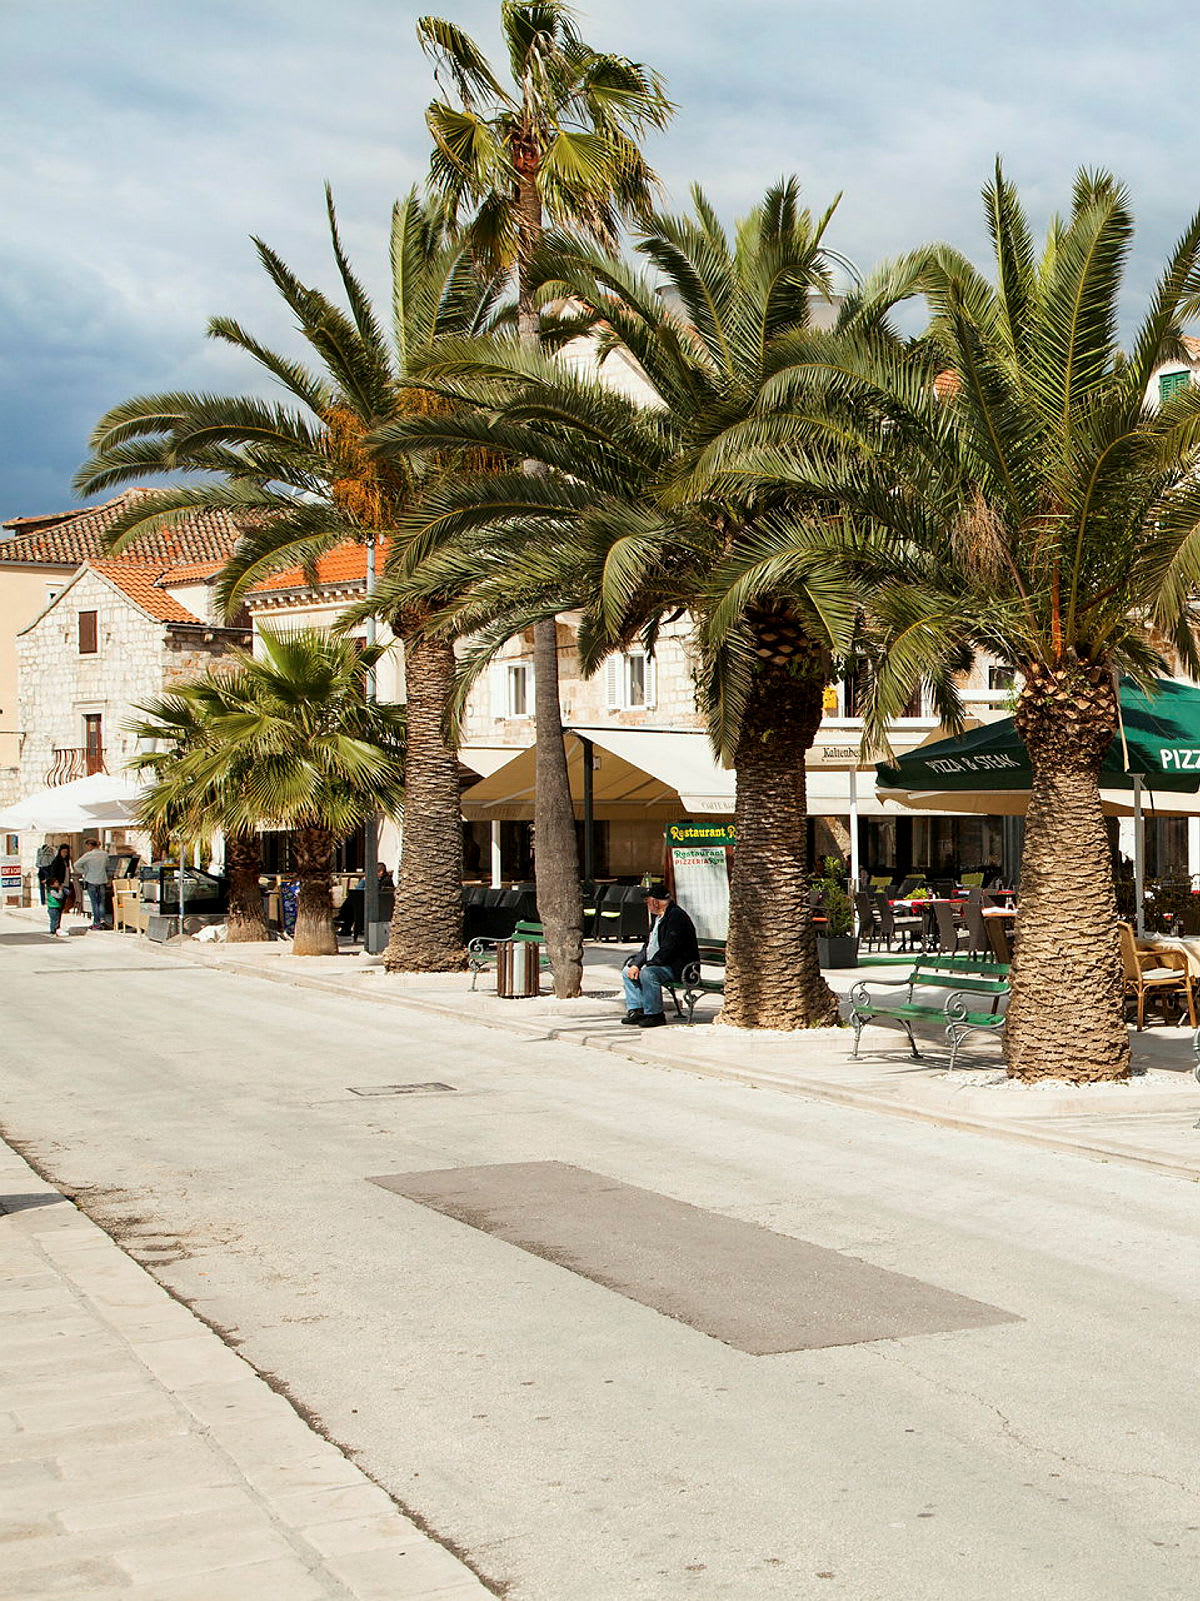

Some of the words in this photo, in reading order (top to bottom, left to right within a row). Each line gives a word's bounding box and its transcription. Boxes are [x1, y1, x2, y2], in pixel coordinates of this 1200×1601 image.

[924, 758, 967, 774] PIZZA
[973, 754, 1021, 770] STEAK
[670, 826, 726, 841] Restaurant
[674, 849, 724, 859] Restaurant
